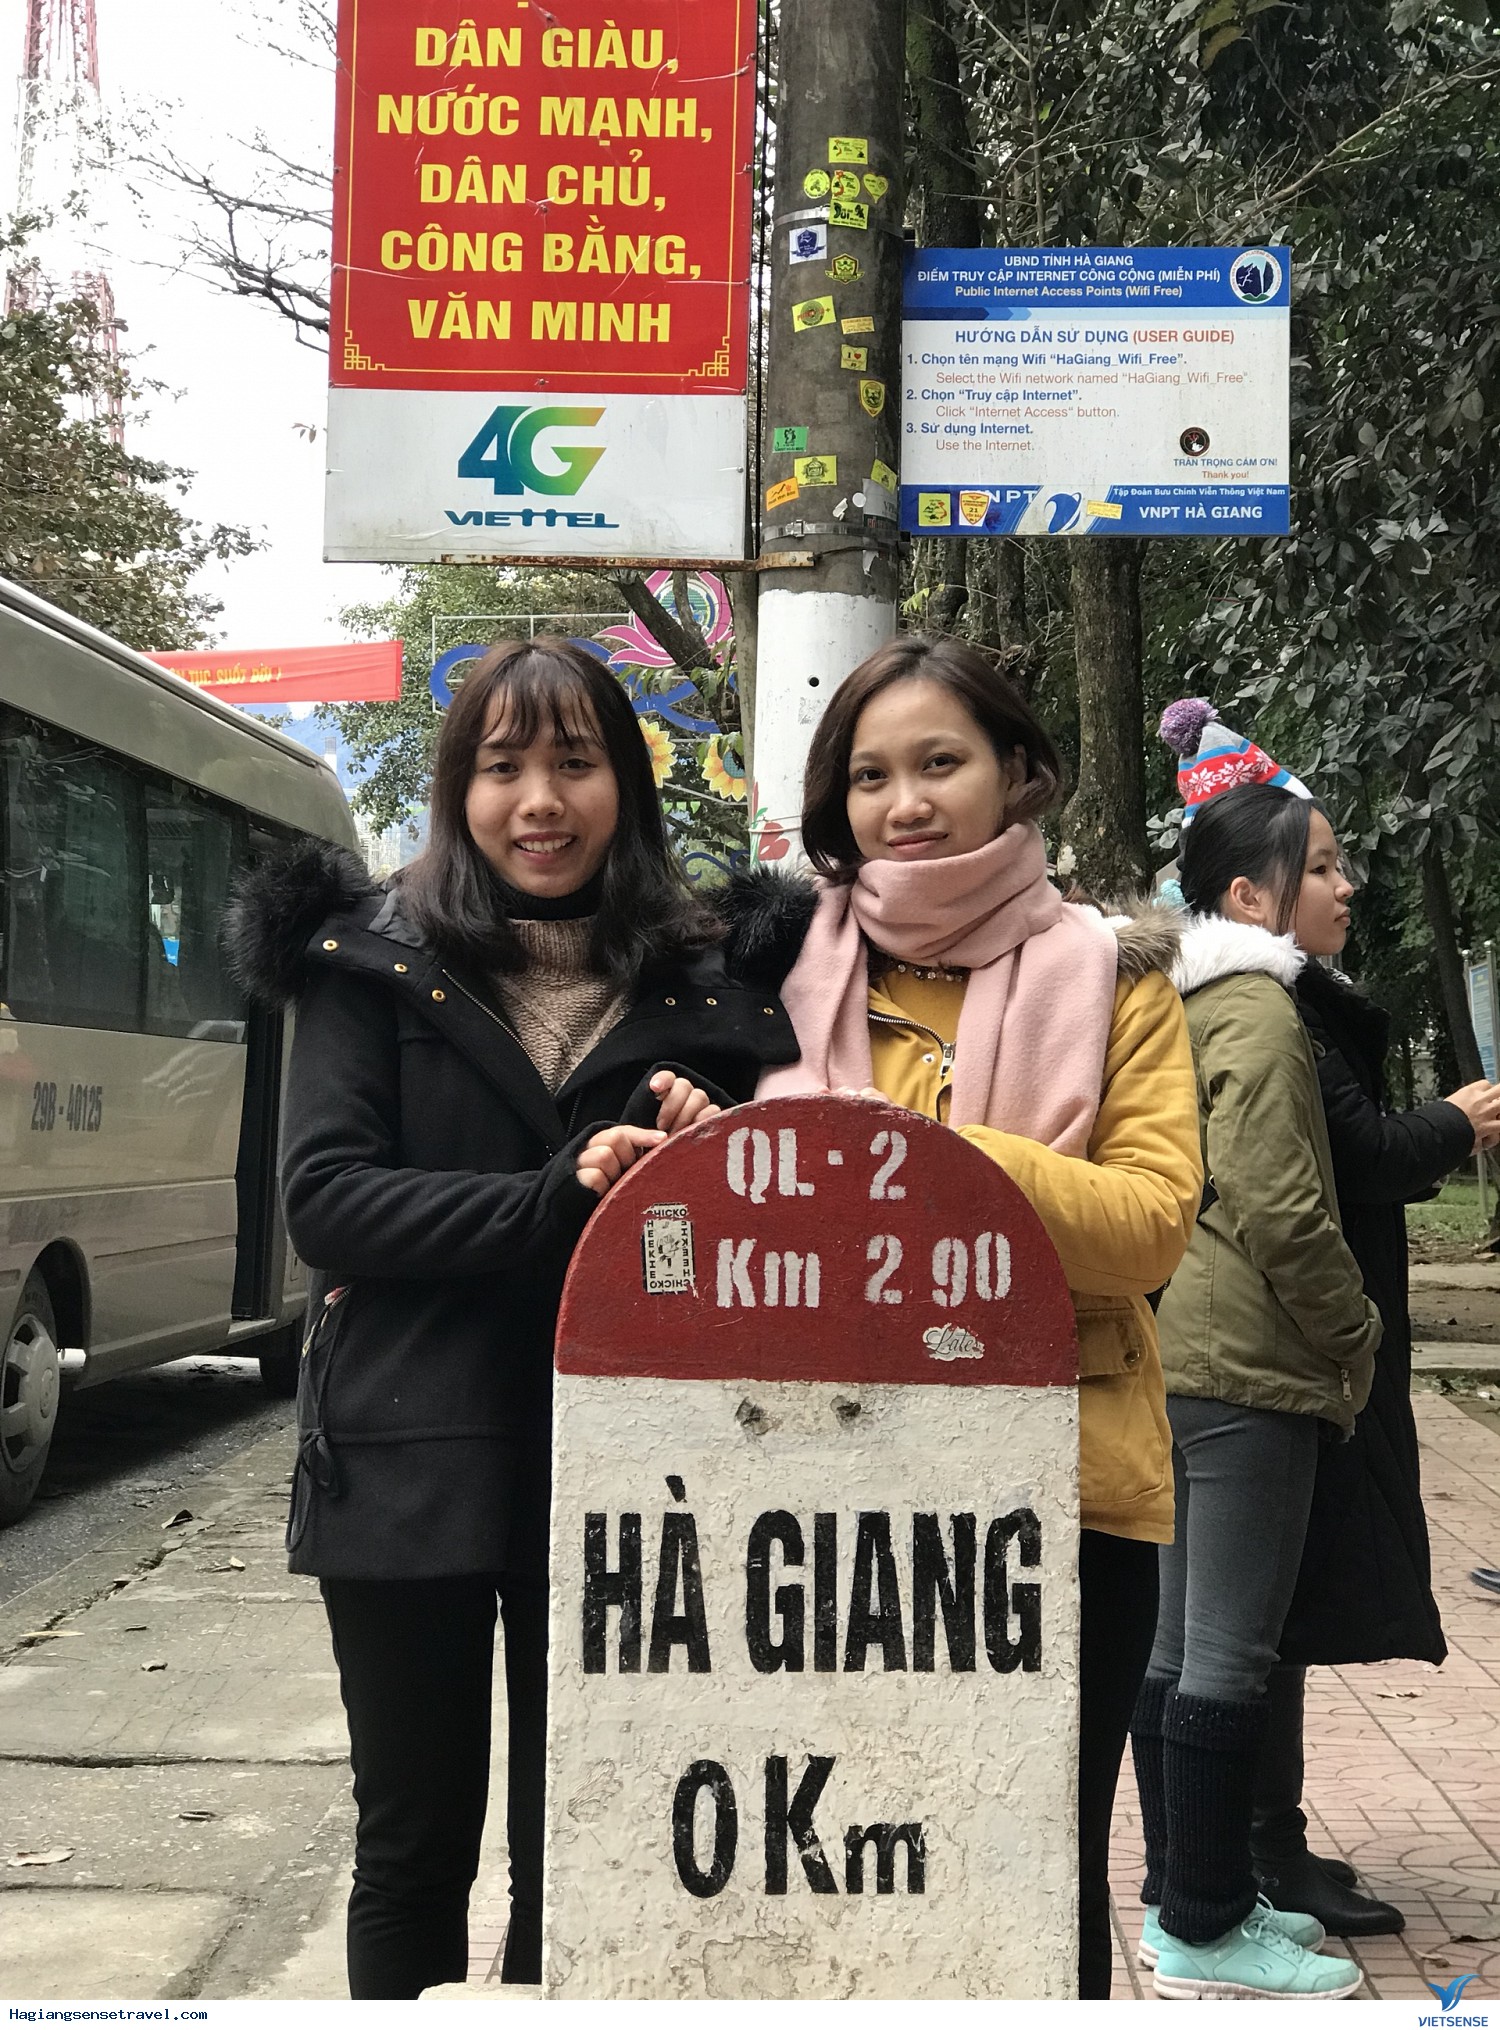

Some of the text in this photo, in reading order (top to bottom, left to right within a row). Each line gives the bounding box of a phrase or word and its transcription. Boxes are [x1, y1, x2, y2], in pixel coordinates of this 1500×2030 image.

[415, 19, 679, 75] DÂN GIÀU,
[377, 83, 713, 147] NƯỚC MẠNH,
[420, 148, 667, 212] DÂN CHỦ,
[381, 214, 701, 280] CÔNG BẰNG,
[1004, 252, 1134, 267] UBND TỈNH HÀ GIANG
[917, 266, 1220, 283] ĐIỂM TRUY CẬP INTERNET CÔNG CỘNG (MIỄN PHÍ)
[955, 285, 1182, 298] Public Internet Access Points (Wifi Free)
[407, 291, 672, 343] VĂN MINH
[955, 325, 1235, 346] HƯỚNG DẪN SỬ DỤNG (USER GUIDE)
[907, 353, 918, 365] 1.
[921, 353, 956, 367] Chọn
[959, 354, 980, 365] tên
[983, 354, 1018, 368] mạng
[1022, 353, 1046, 365] Wifi
[936, 371, 975, 384] Select
[977, 372, 996, 384] the
[1000, 372, 1022, 384] Wifi
[1025, 372, 1074, 384] network
[1077, 373, 1118, 384] named
[906, 389, 1082, 403] 2. Chọn “Truy cập Internet”.
[936, 406, 966, 418] Click
[969, 406, 1021, 418] “Internet
[1077, 406, 1120, 418] button.
[906, 422, 1033, 437] 3. Sử dụng Internet.
[457, 405, 607, 496] 4G
[936, 439, 1035, 451] Use the Internet.
[1200, 458, 1234, 468] TRỌNG
[1202, 470, 1249, 481] Thank you!
[1113, 486, 1286, 497] Tập Đoàn Bưu Chính Viễn Thông Việt Nam
[1138, 503, 1263, 519] VNPT HÀ GIANG
[31, 1081, 57, 1132] 29B
[66, 1083, 103, 1132] 40125
[727, 1126, 815, 1204] QL
[869, 1130, 908, 1200] 2
[716, 1231, 1012, 1308] Km 2 90
[582, 1475, 1042, 1674] HÀ GIANG
[765, 1756, 926, 1894] Km
